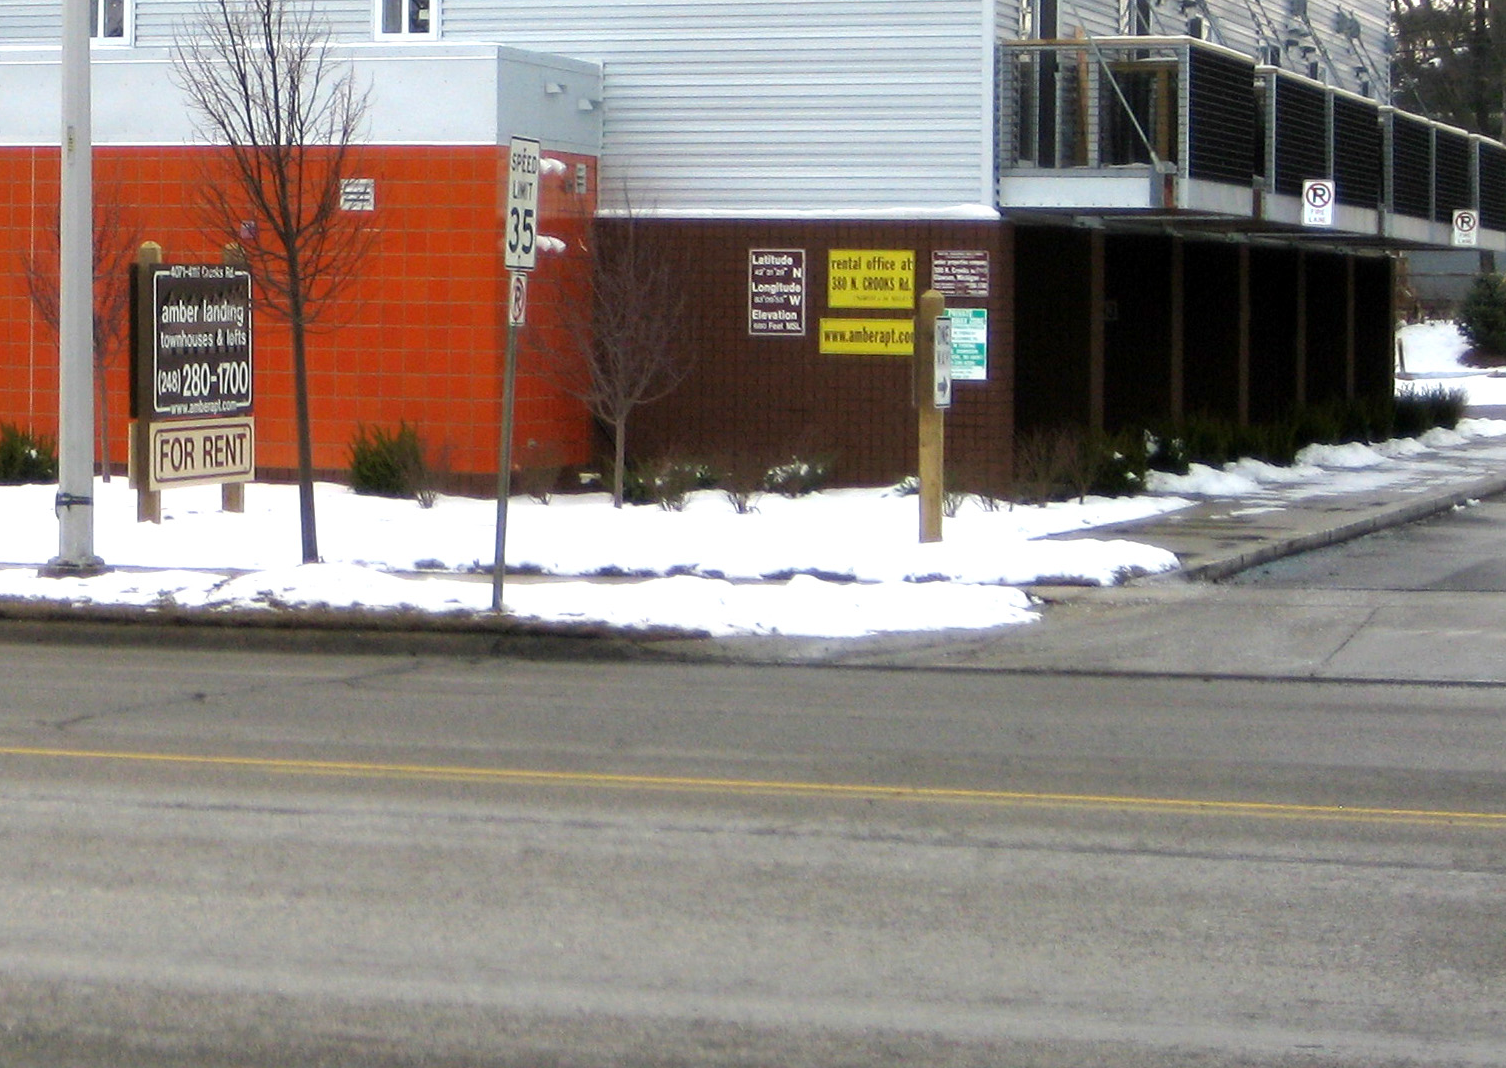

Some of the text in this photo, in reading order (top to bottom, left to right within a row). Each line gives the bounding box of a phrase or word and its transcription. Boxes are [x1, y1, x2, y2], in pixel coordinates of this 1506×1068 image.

[511, 152, 537, 174] SPEED
[513, 179, 534, 200] LIMIT
[508, 206, 534, 255] 35
[752, 255, 793, 265] Latitude
[831, 256, 913, 271] rental office at
[792, 267, 802, 278] N
[752, 282, 802, 294] Longitude
[862, 276, 895, 291] CROOKS
[788, 295, 802, 306] W
[161, 299, 244, 328] amber landing
[752, 309, 798, 320] Elevation
[160, 328, 247, 349] townhouses & lofts
[158, 361, 249, 397] (248) 280-1700
[170, 399, 238, 415] www.amberapt.com
[159, 432, 247, 473] FOR RENT
